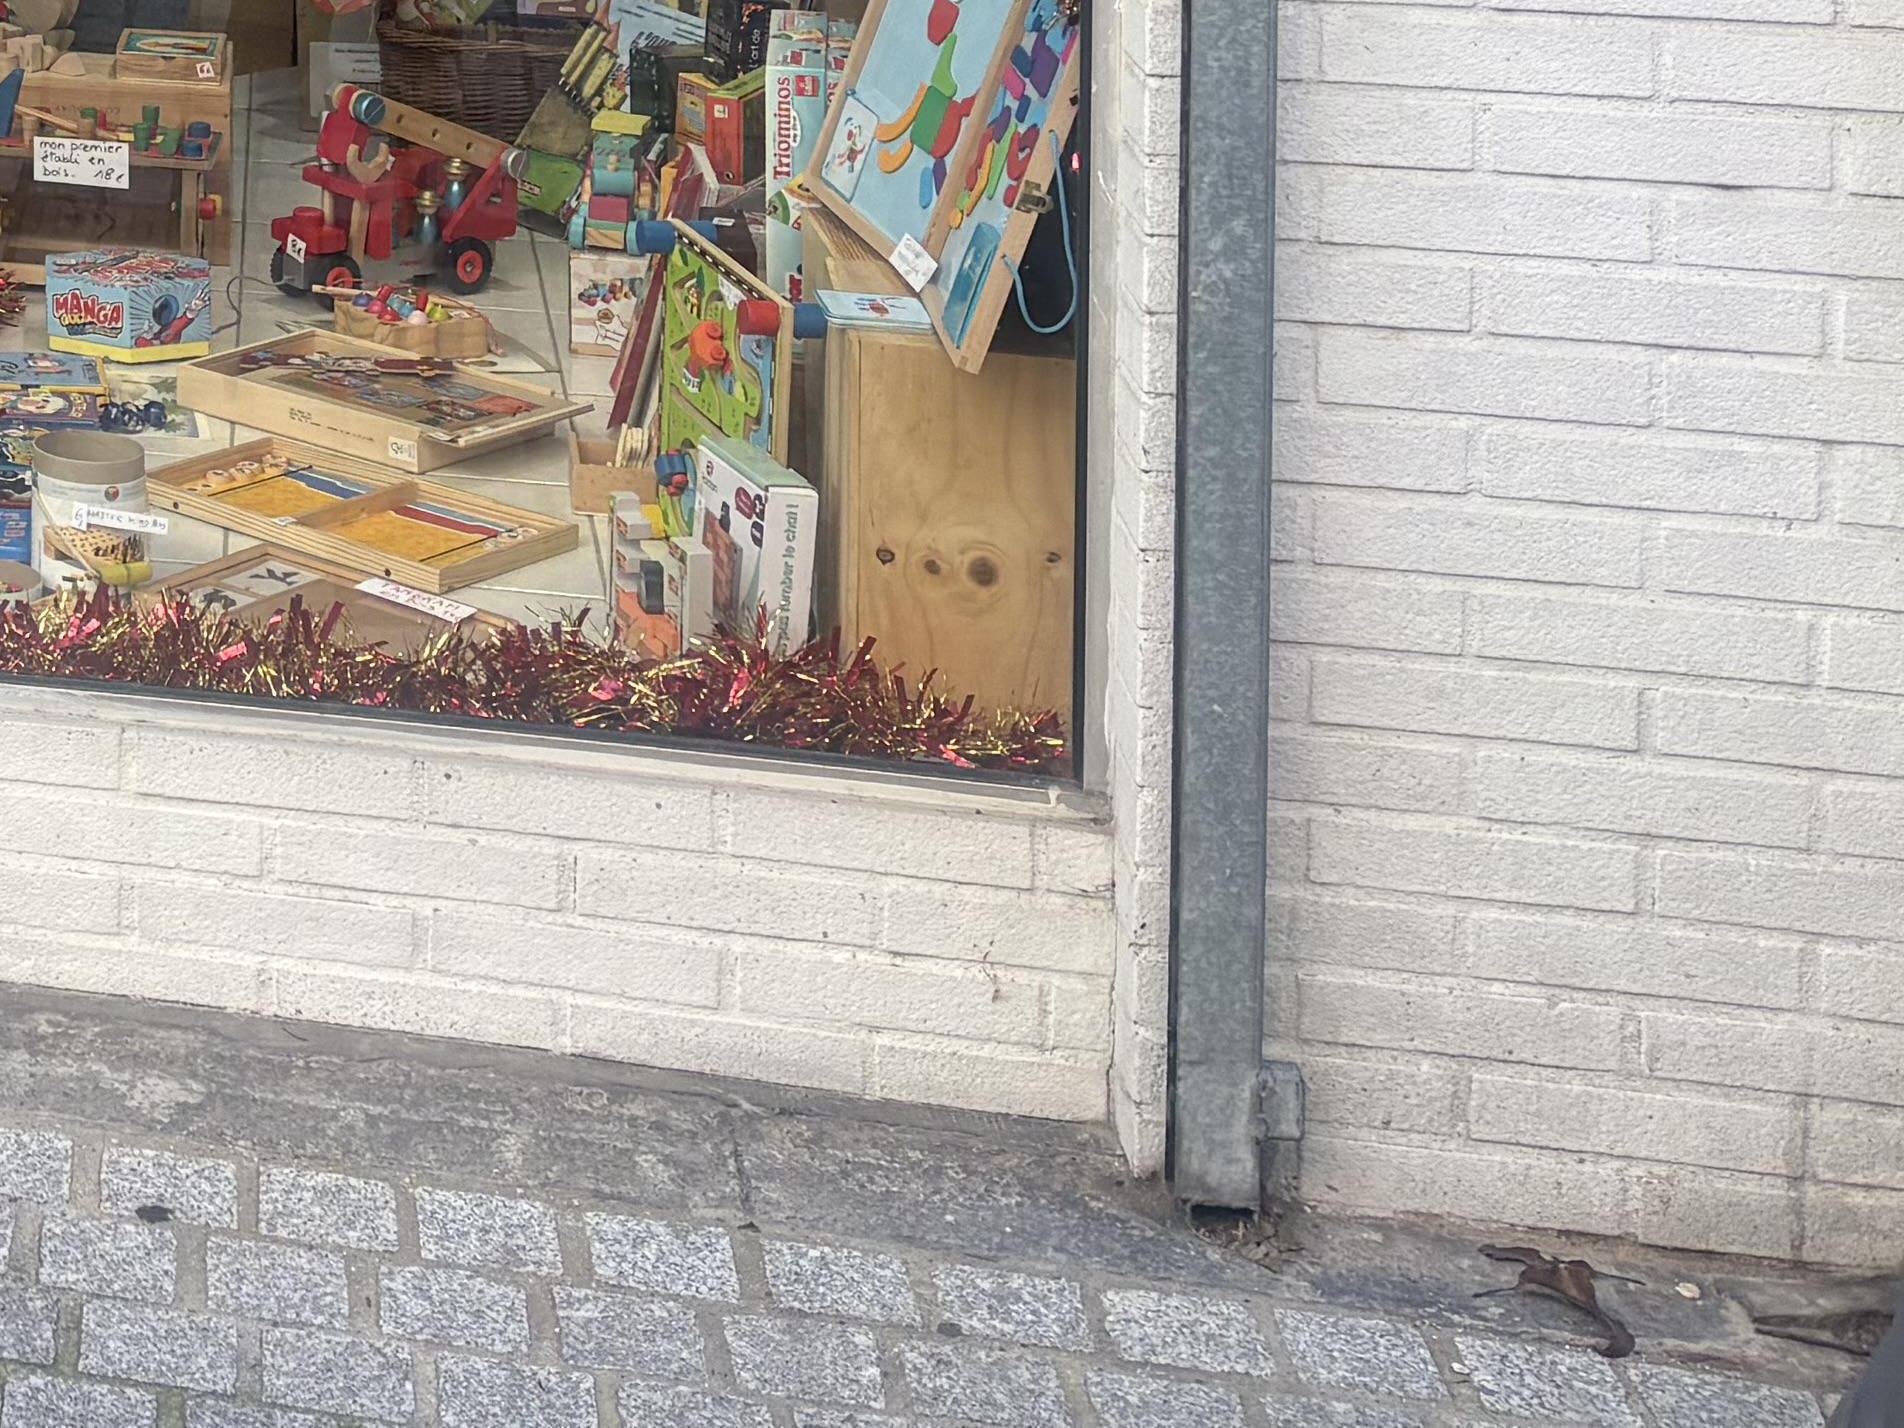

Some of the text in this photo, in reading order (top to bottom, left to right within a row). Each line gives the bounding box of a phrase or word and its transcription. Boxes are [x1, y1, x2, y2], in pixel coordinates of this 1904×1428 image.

[773, 75, 792, 181] Triominos
[40, 141, 122, 153] mon premier
[41, 151, 105, 166] établi en
[53, 290, 124, 329] MANGA
